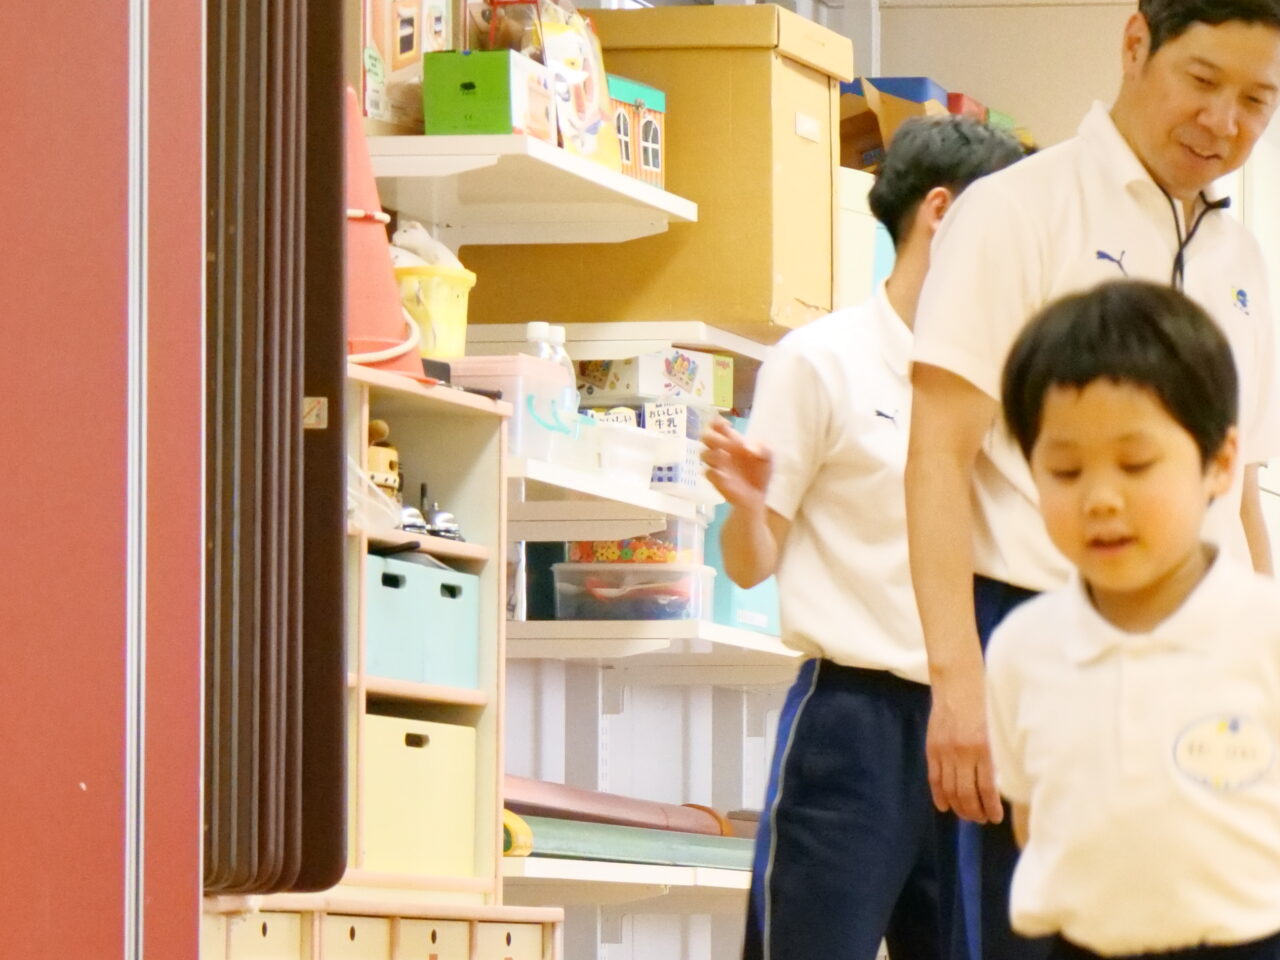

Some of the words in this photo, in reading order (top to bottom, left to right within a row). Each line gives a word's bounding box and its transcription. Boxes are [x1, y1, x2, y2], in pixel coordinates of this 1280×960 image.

[649, 407, 683, 418] おいしい
[655, 417, 678, 430] 牛乳
